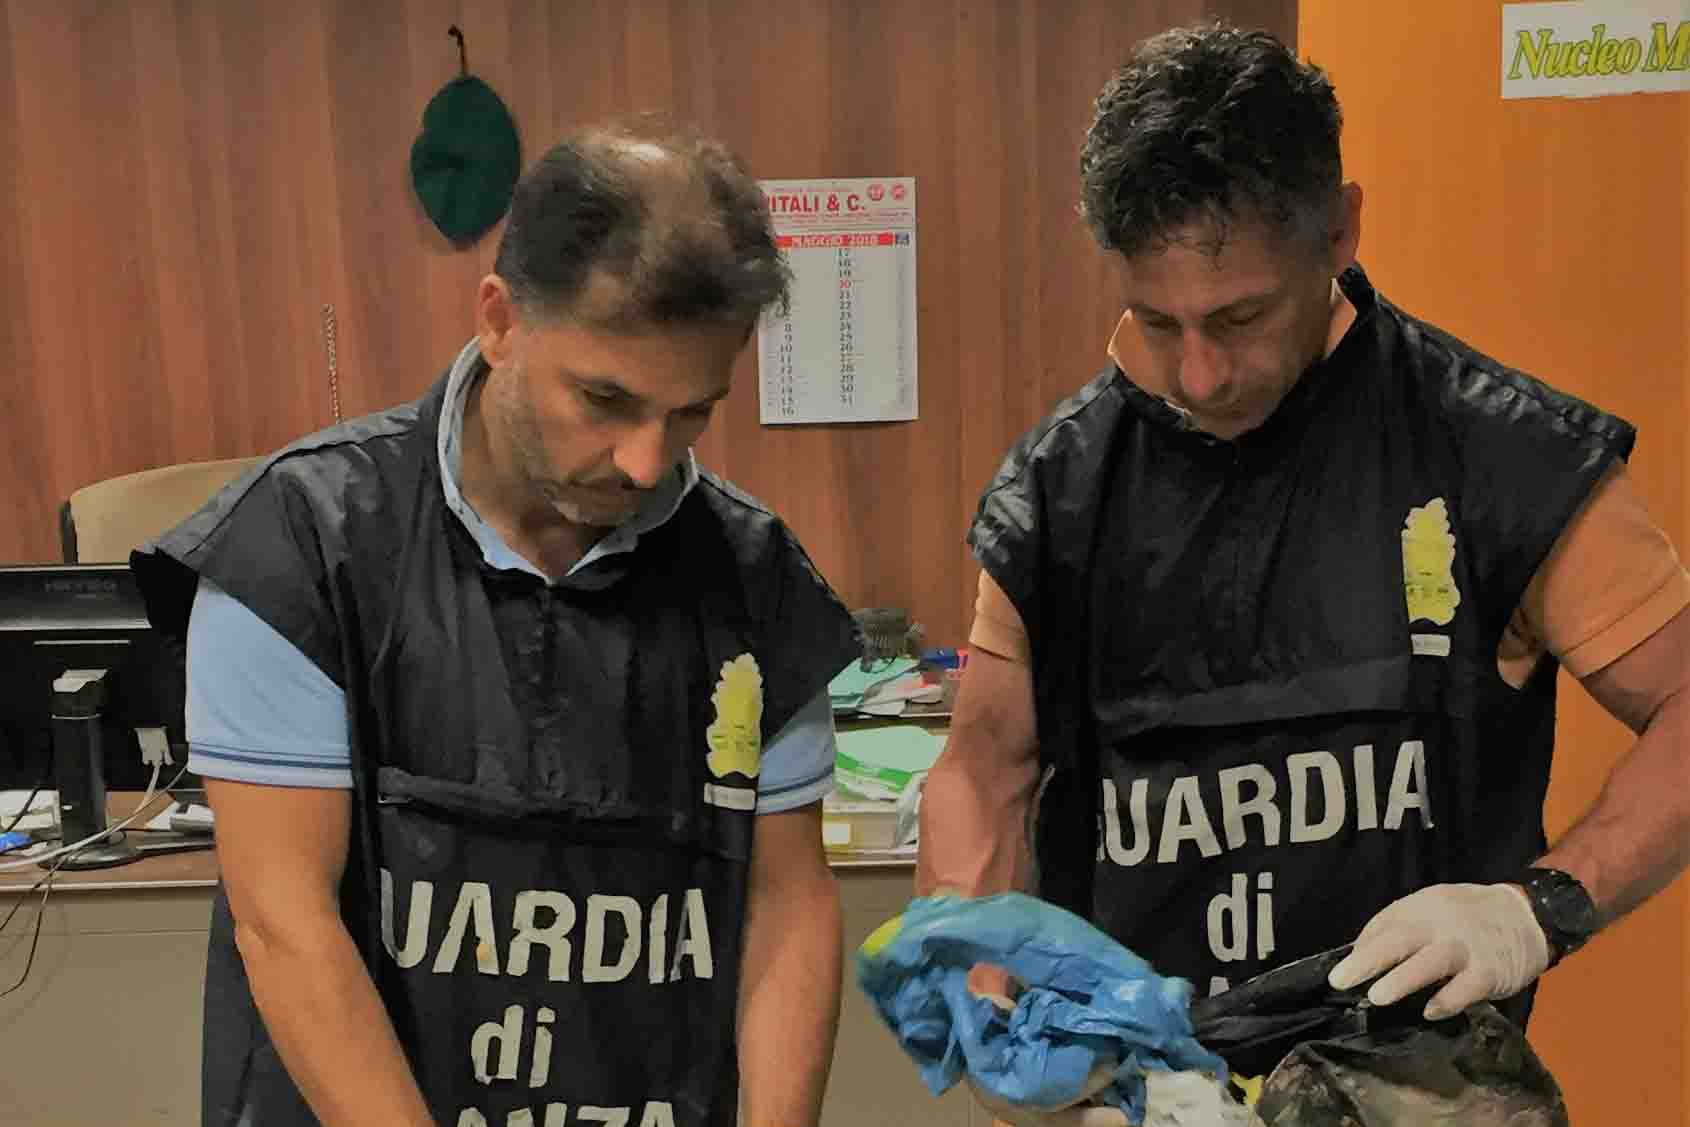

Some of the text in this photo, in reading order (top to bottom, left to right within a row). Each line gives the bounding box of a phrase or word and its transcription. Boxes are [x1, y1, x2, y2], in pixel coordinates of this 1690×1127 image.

[1507, 24, 1641, 80] Nucleo
[768, 195, 820, 213] ITALI
[827, 193, 840, 212] &
[1097, 739, 1435, 867] UARDIA
[380, 867, 713, 984] UARDIA
[1207, 872, 1275, 962] di
[470, 1004, 556, 1088] di
